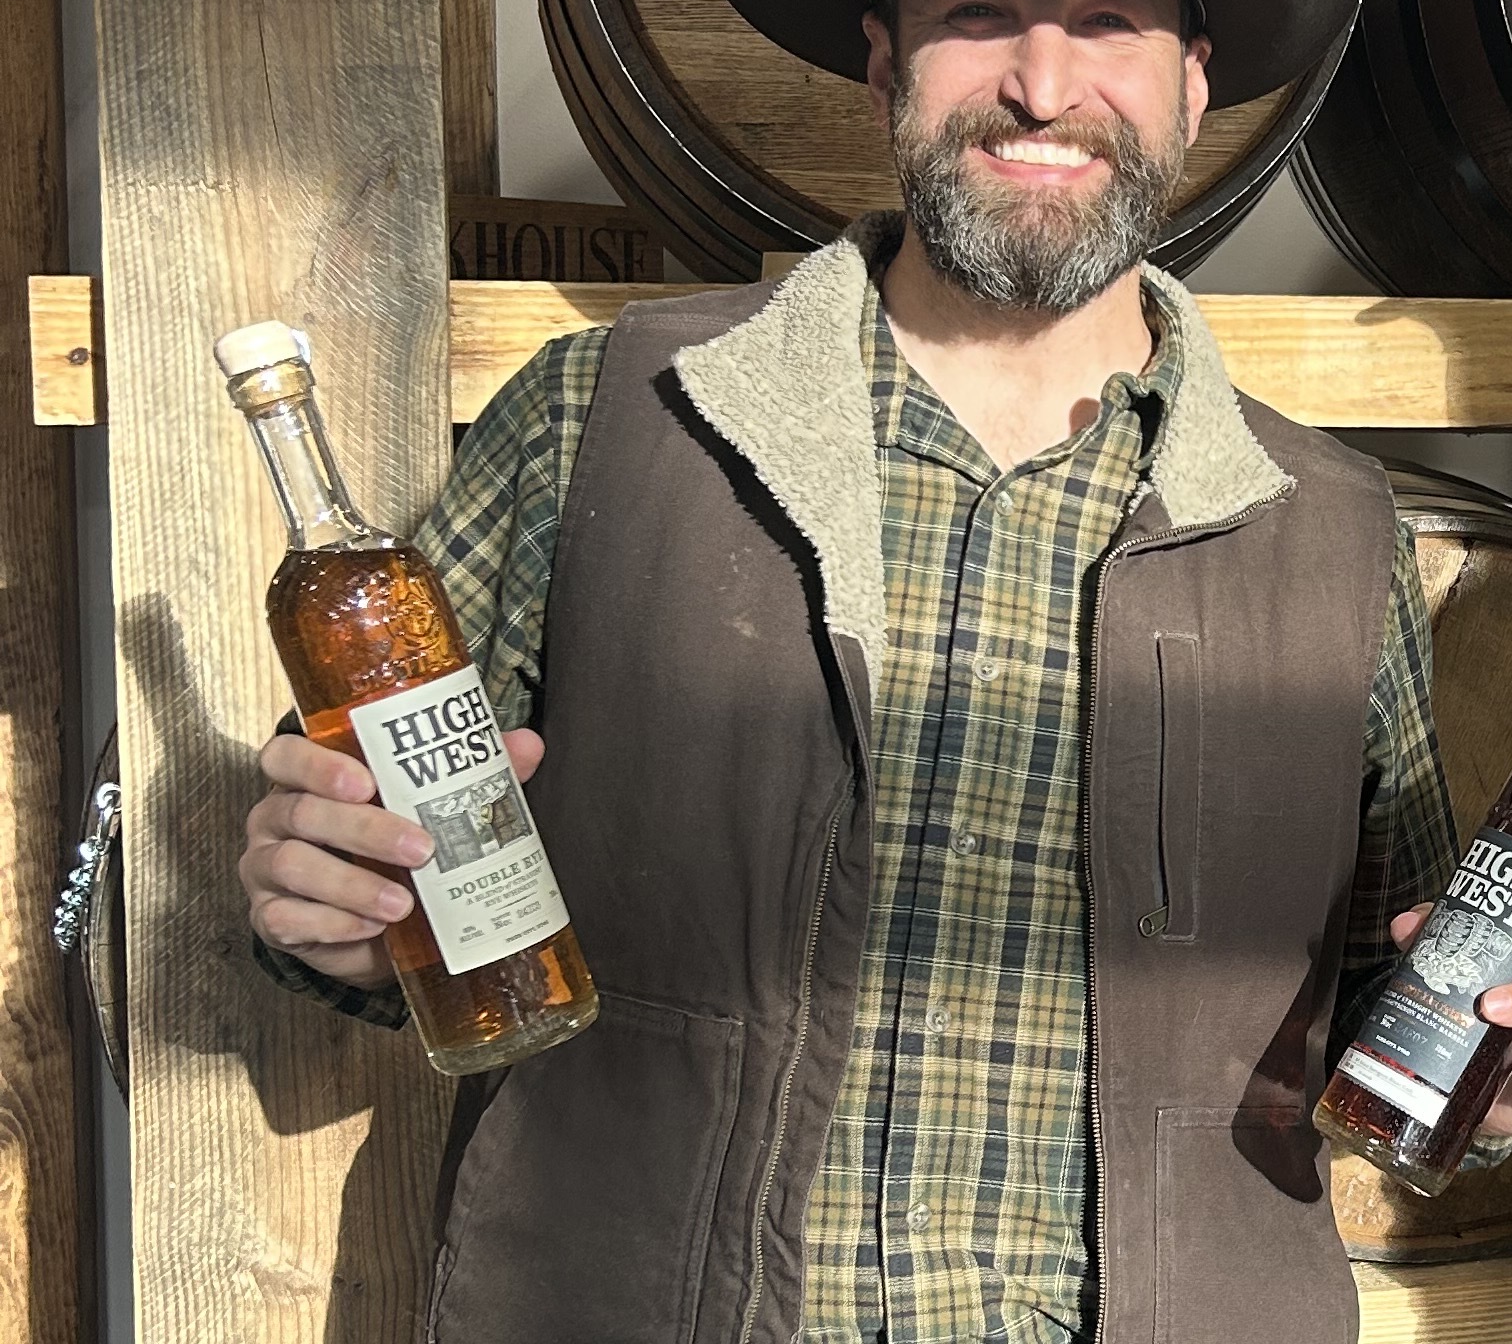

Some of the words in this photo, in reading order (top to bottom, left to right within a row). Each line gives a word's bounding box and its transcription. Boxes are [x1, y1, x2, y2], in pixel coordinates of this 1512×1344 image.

[382, 686, 492, 757] HIGH
[395, 723, 503, 789] WEST
[447, 862, 522, 901] DOUBLE
